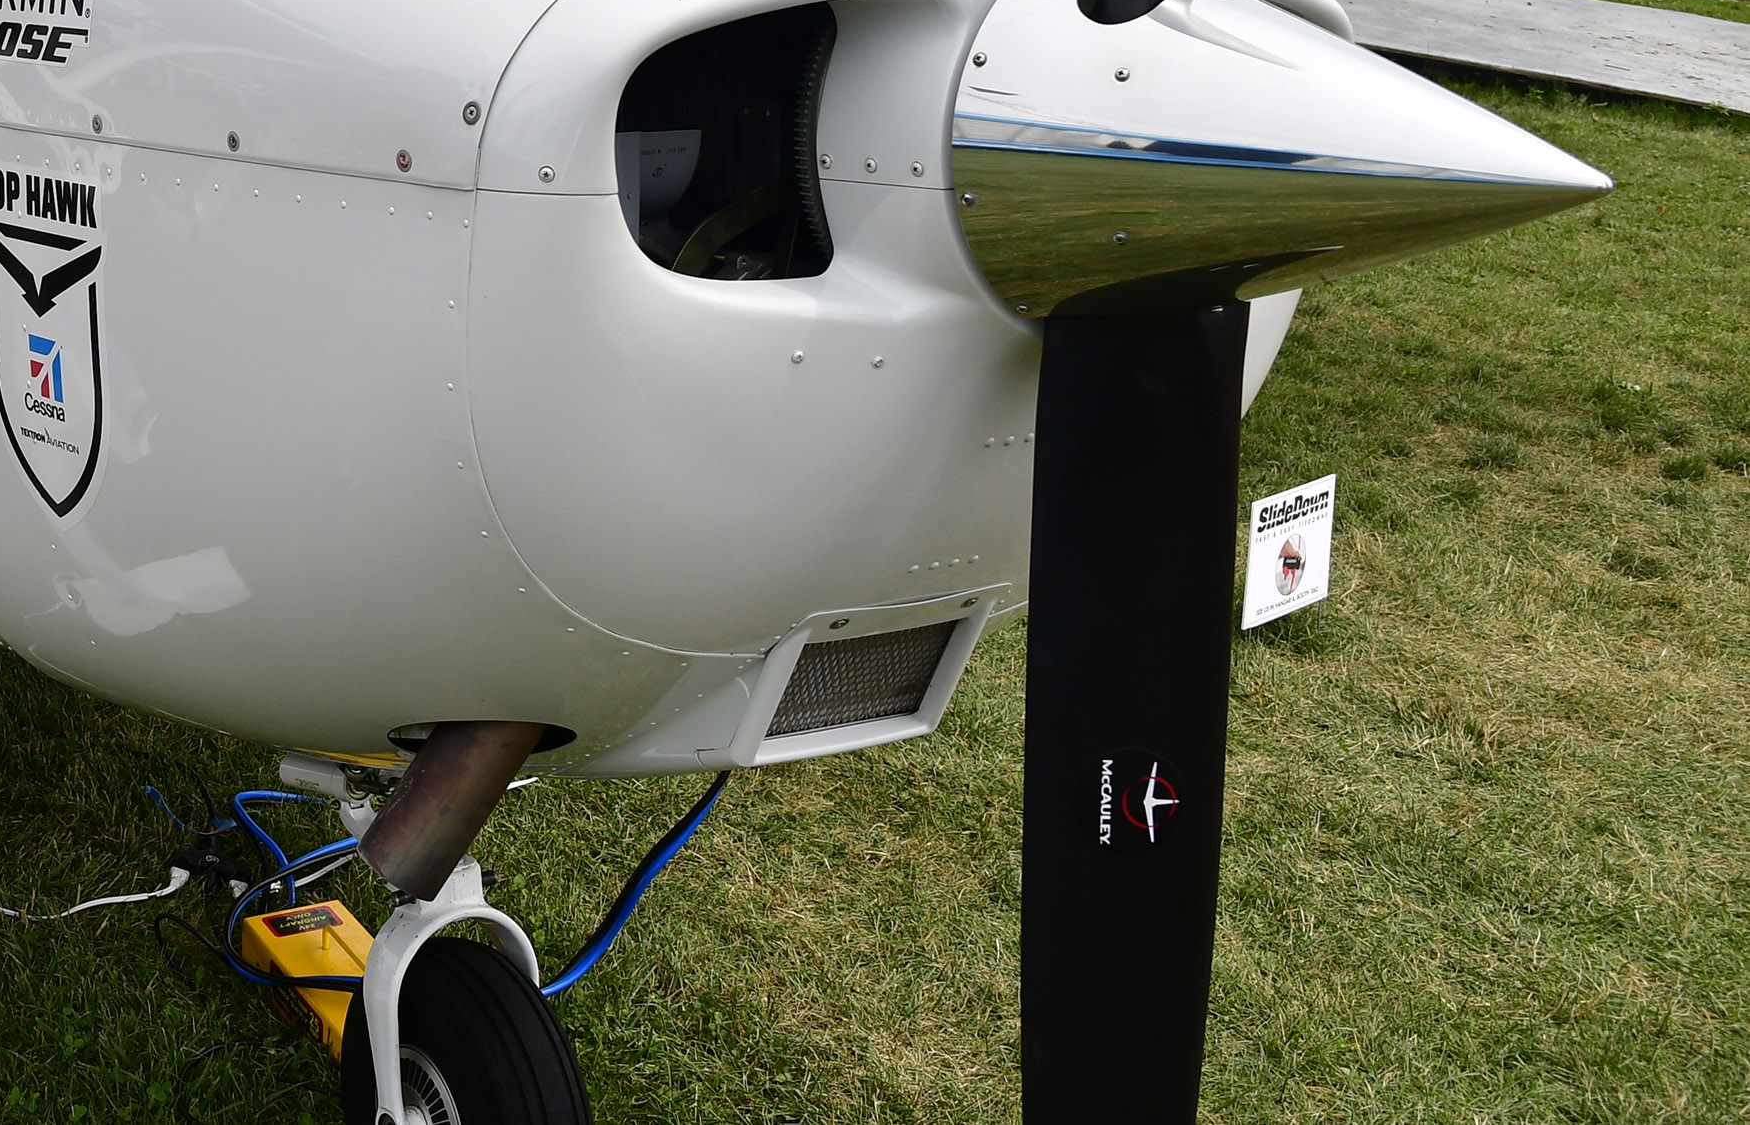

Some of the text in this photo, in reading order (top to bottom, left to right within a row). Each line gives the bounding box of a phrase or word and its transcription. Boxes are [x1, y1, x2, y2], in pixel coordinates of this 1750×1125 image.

[26, 174, 98, 228] HAWK
[25, 392, 65, 422] Cessna
[20, 426, 79, 454] TEXTRON AVIATION
[1257, 490, 1329, 533] SlideDown
[278, 914, 327, 929] AIRCRAFT
